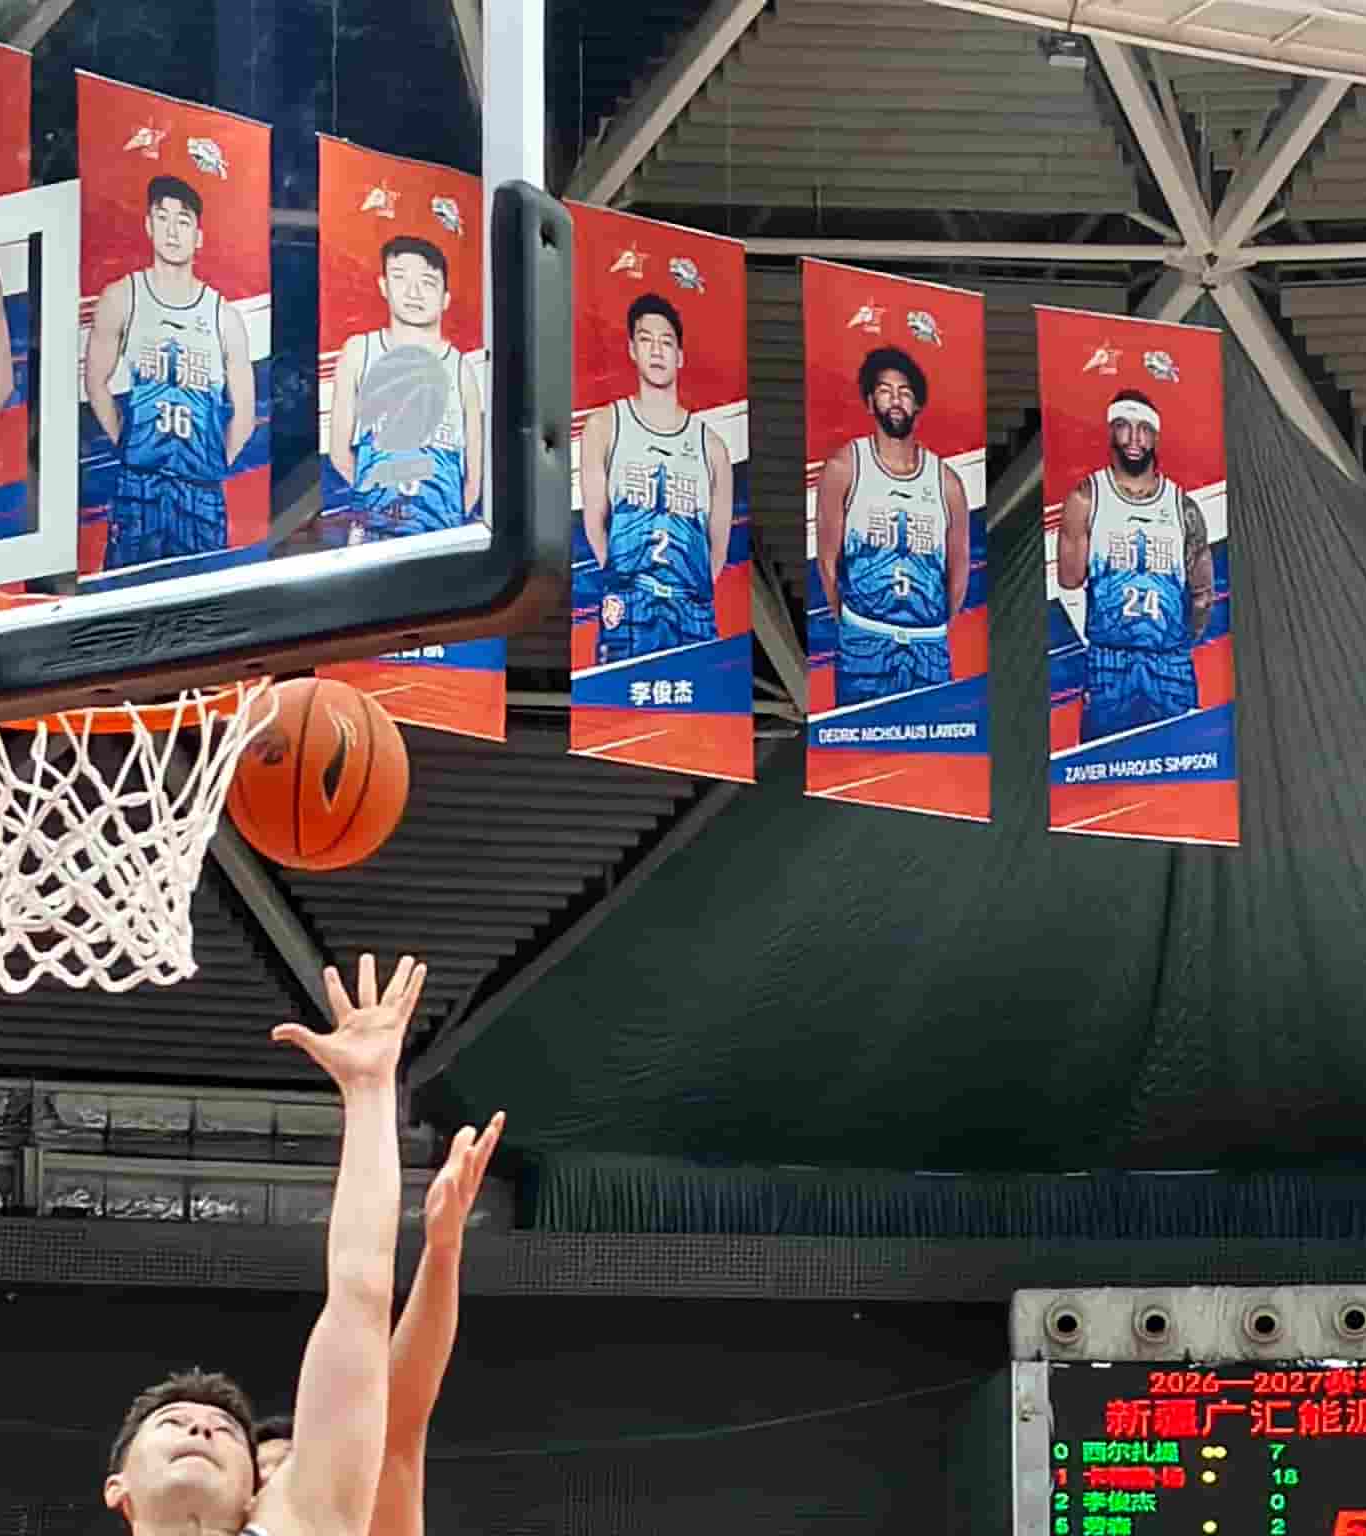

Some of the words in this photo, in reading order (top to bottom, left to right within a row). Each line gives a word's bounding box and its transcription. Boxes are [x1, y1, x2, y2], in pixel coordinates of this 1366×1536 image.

[154, 400, 192, 440] 36
[650, 528, 669, 566] 2
[1121, 584, 1163, 621] 24
[628, 679, 694, 706] 李俊杰
[1109, 758, 1163, 778] MARQUIS
[1165, 752, 1218, 775] SIMPSON
[1268, 1443, 1286, 1460] 7
[1053, 1492, 1069, 1511] 2
[1269, 1492, 1286, 1510] 0
[1270, 1517, 1286, 1535] 2
